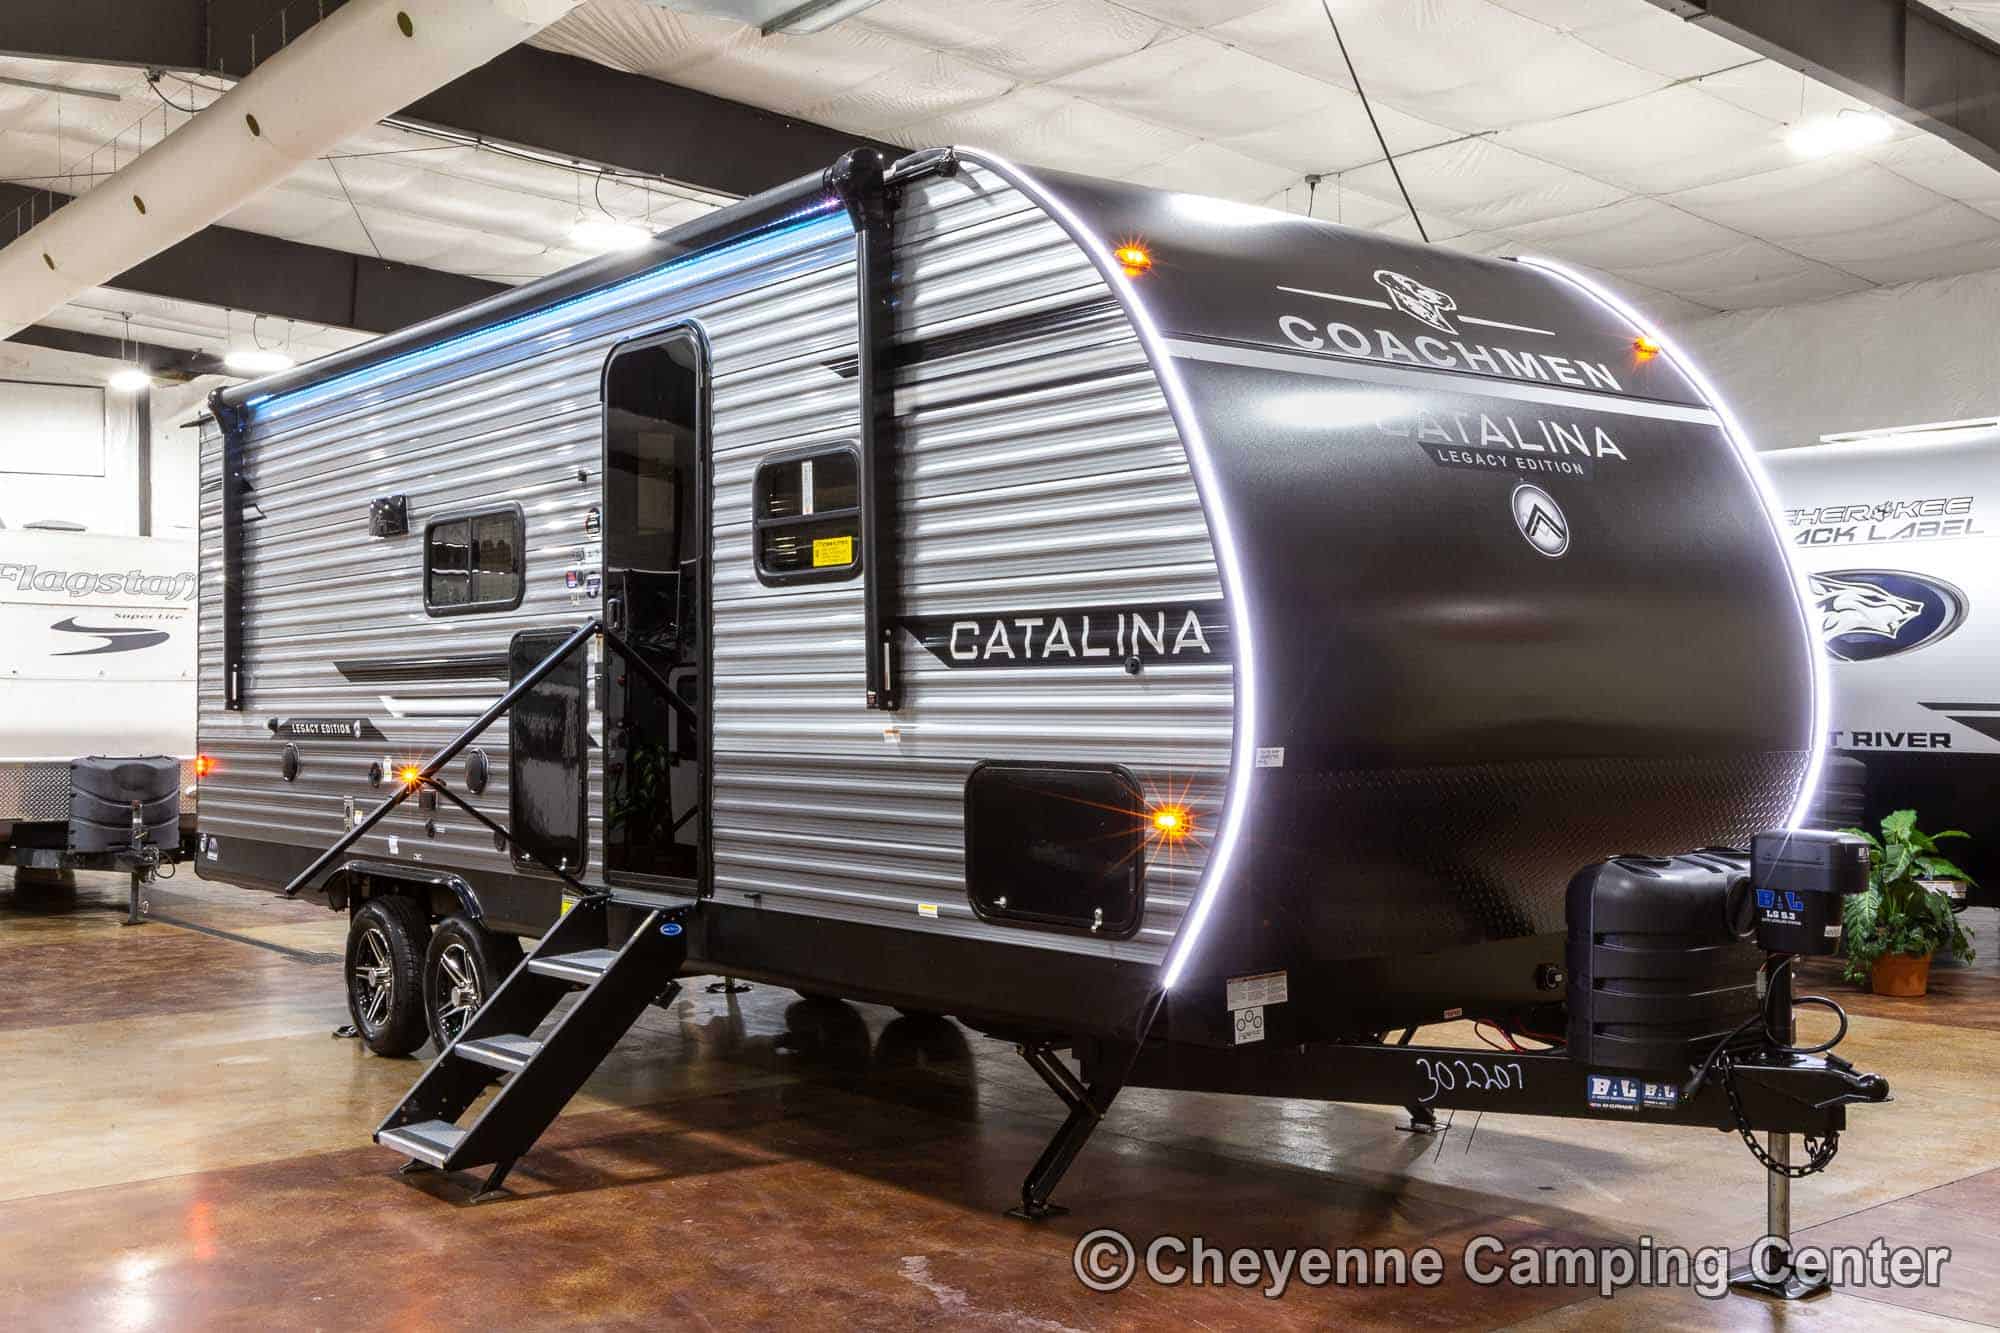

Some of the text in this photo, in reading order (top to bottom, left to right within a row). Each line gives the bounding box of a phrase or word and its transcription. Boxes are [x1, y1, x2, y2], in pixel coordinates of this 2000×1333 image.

[1278, 314, 1623, 391] COACHMEN
[1437, 449, 1584, 475] LEGACY EDITION
[1867, 518, 1985, 542] LABEL
[950, 609, 1211, 661] CATALINA
[291, 723, 351, 734] LEGACY EDITION
[1851, 731, 1952, 748] RIVER
[1415, 1057, 1524, 1103] 302207
